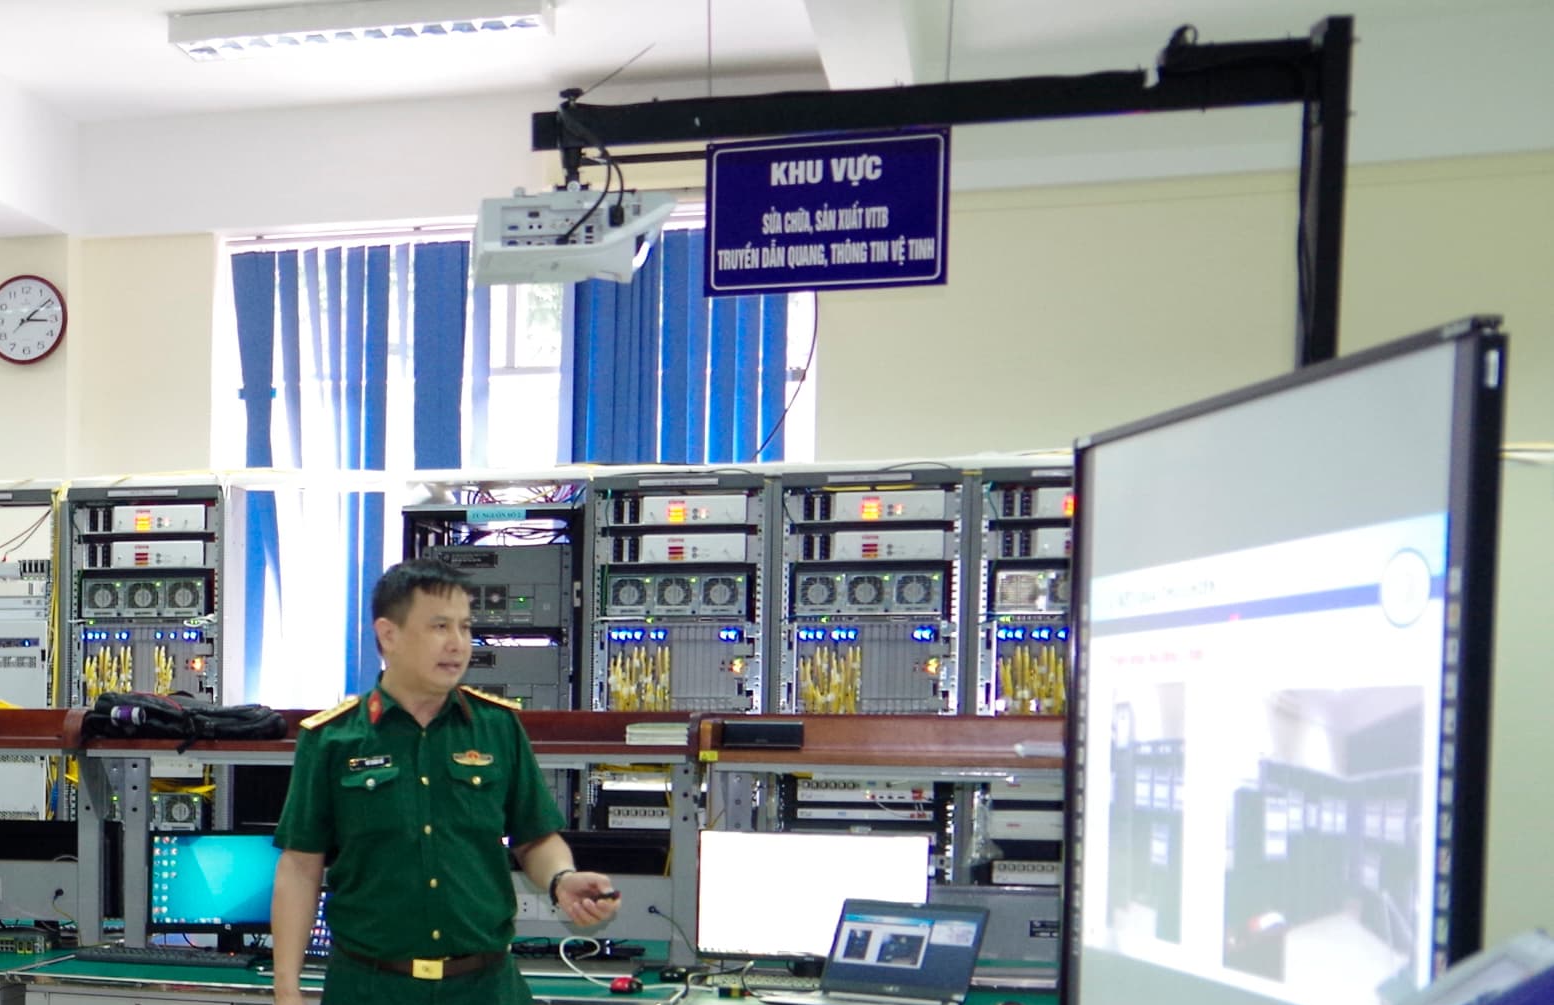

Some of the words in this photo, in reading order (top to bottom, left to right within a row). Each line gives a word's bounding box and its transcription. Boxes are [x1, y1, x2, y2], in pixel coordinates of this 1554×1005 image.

[770, 159, 823, 186] KHU
[830, 154, 882, 186] VỰC
[762, 206, 782, 235] SỬA
[815, 202, 836, 232] SẢN
[837, 200, 864, 230] XUẤT
[865, 206, 889, 229] VTTB
[787, 244, 828, 269] QUANG,
[830, 238, 867, 265] THÔNG
[870, 240, 889, 262] TIN
[891, 235, 905, 266] VỆ
[908, 237, 935, 260] TINH
